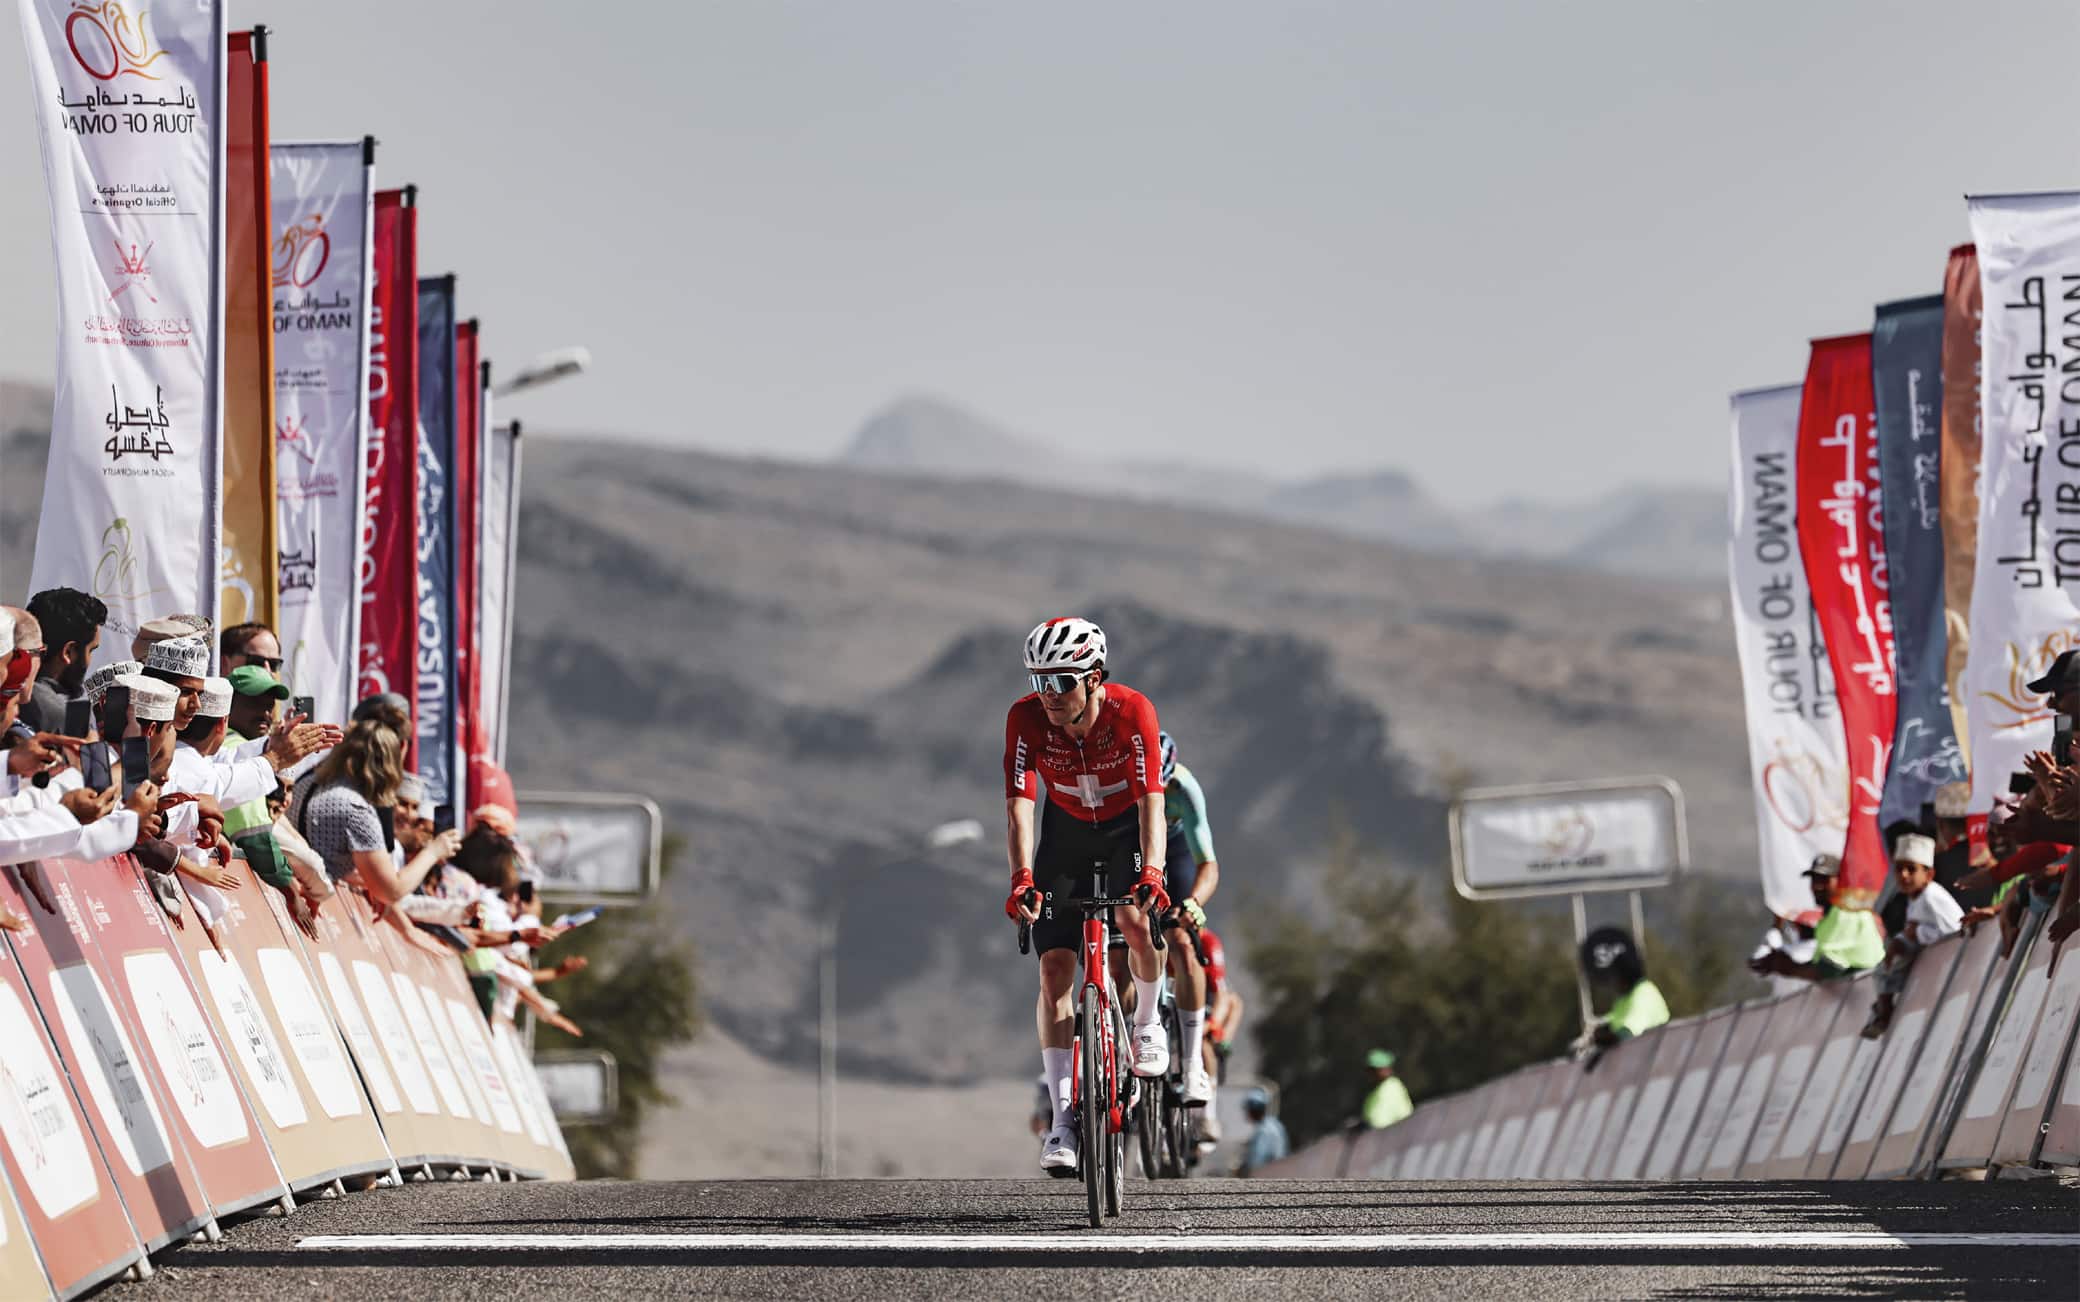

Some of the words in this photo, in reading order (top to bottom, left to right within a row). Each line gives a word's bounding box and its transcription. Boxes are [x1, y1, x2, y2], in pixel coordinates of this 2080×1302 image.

[273, 315, 292, 334] OF
[297, 312, 352, 333] OMAN
[416, 572, 446, 738] MUSCAT
[1014, 735, 1028, 791] GIANT
[1131, 734, 1147, 787] GIANT
